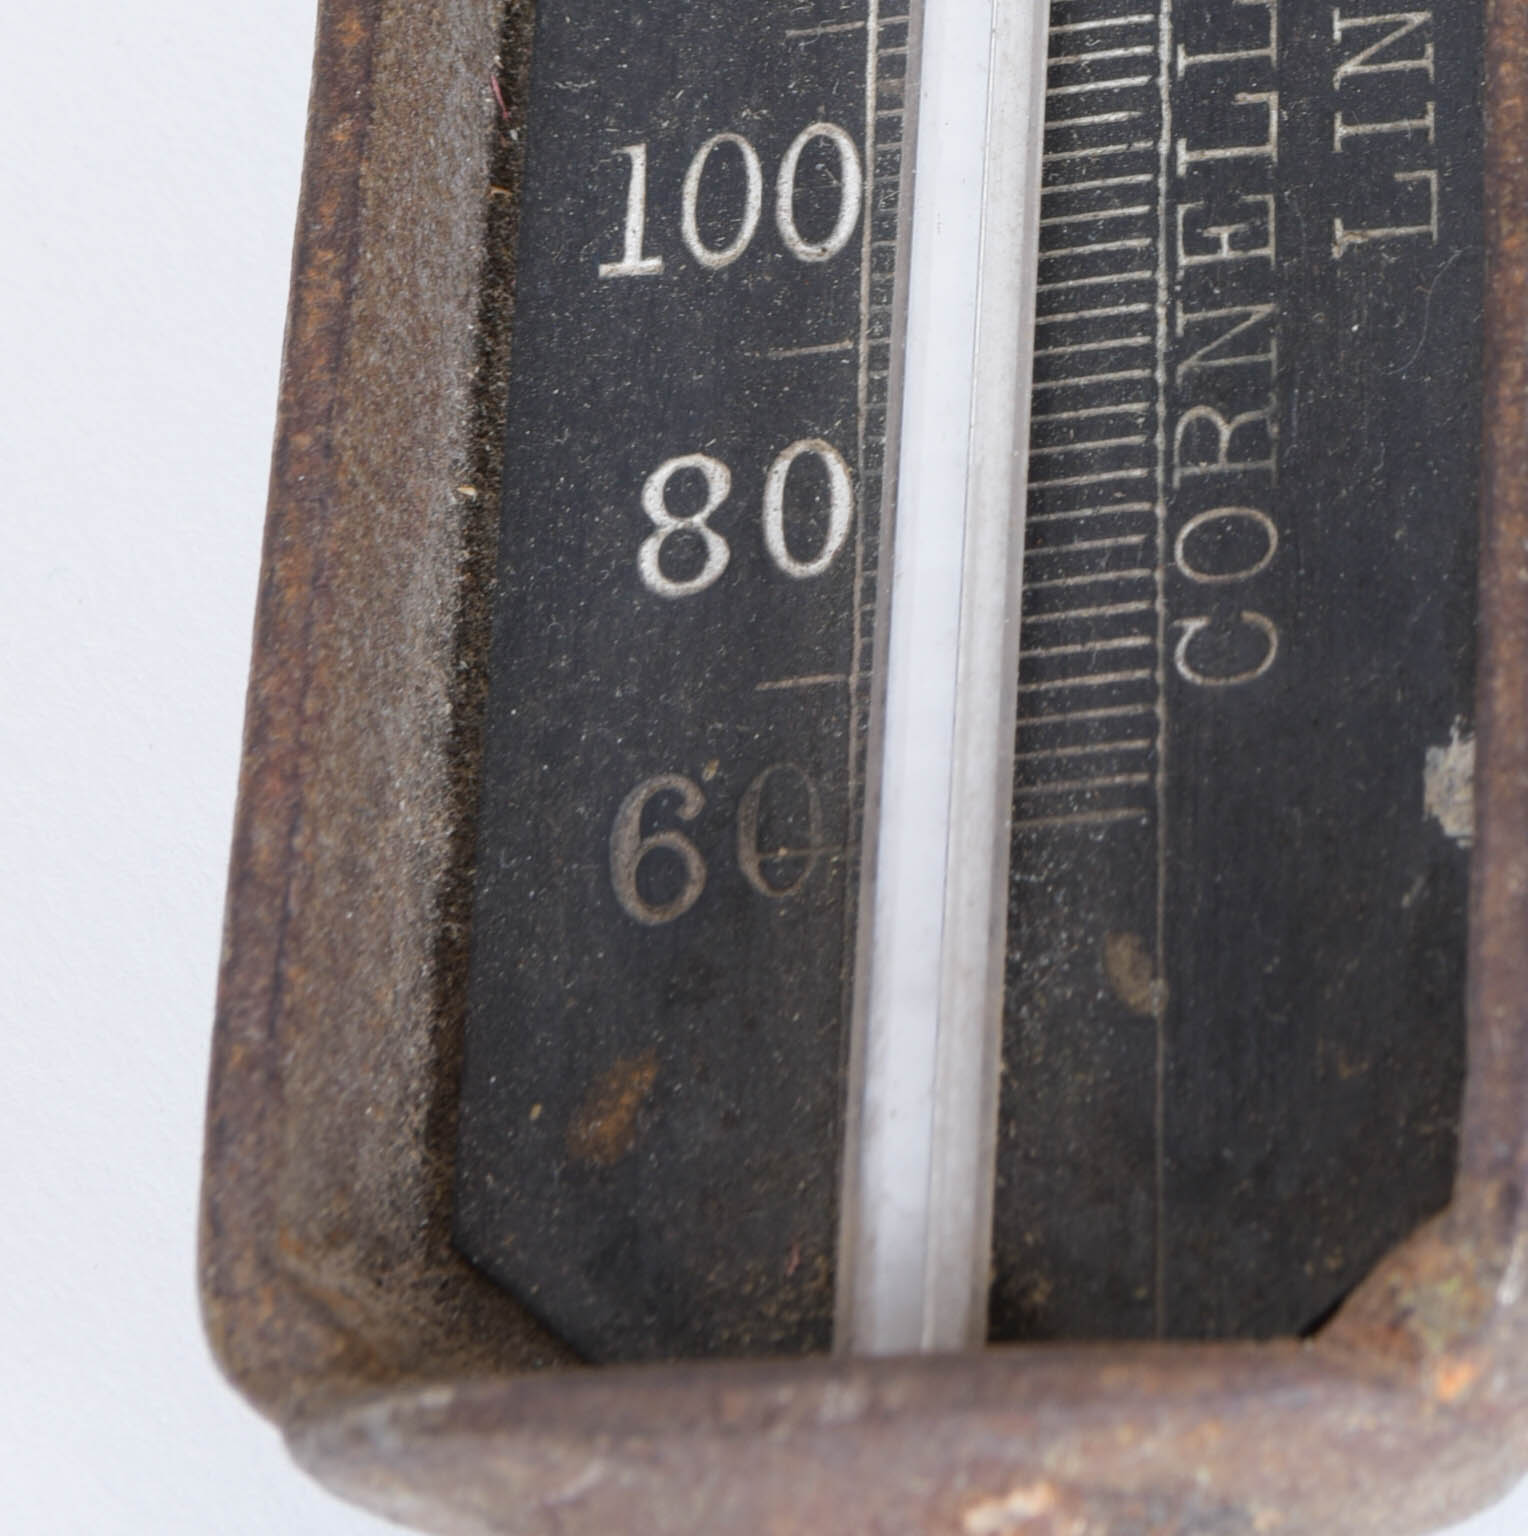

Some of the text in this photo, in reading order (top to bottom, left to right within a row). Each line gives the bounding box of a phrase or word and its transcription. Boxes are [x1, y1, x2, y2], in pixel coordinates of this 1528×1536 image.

[597, 122, 863, 278] 100
[637, 437, 854, 599] 80
[608, 761, 825, 925] 60
